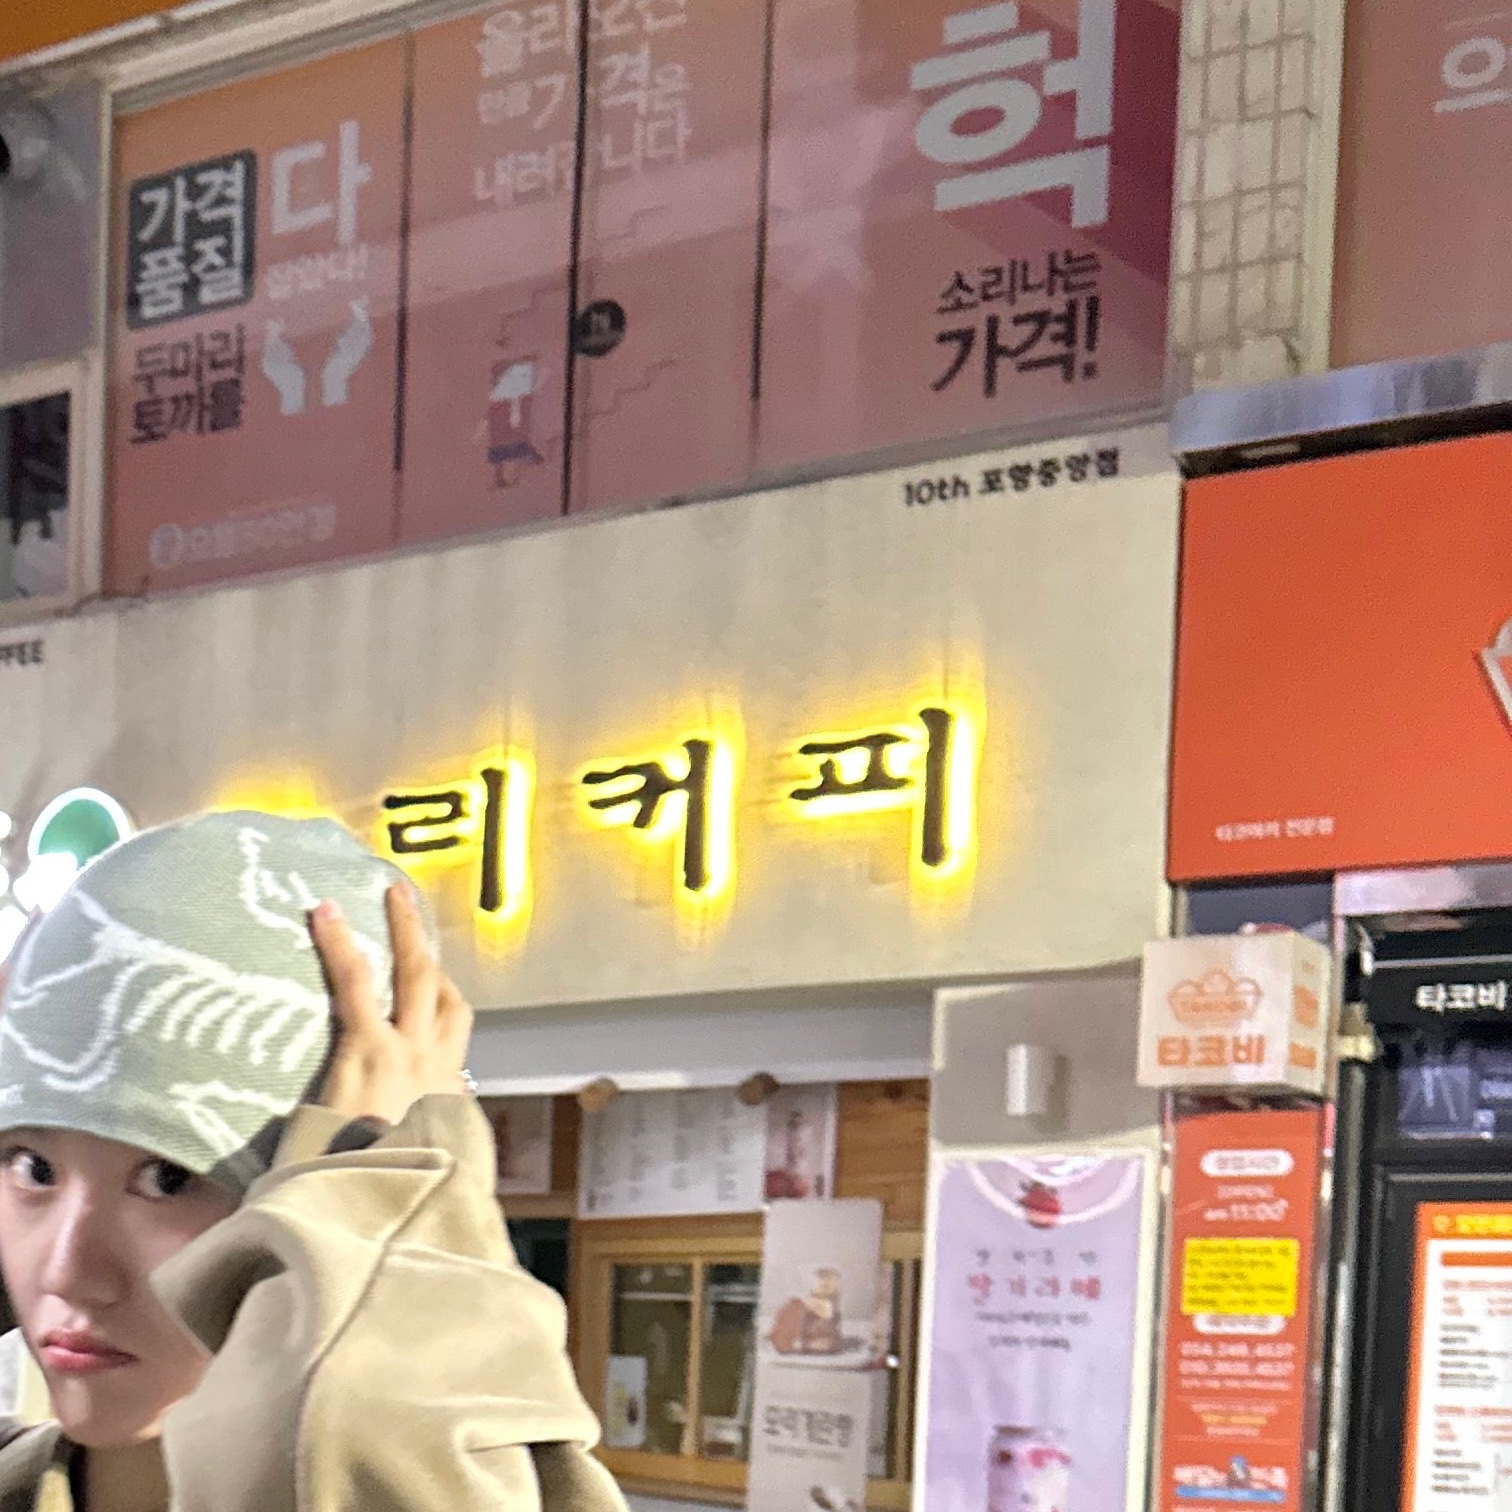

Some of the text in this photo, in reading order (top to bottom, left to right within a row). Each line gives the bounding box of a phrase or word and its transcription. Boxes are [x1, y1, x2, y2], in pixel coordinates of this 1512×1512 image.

[910, 0, 1116, 229] 헉
[138, 158, 247, 244] 가격
[270, 118, 374, 246] 다
[135, 232, 247, 320] 품질
[935, 250, 1102, 315] 소리나는
[133, 322, 245, 396] 두마리
[930, 297, 1101, 398] 가격!
[903, 471, 971, 508] 10th
[381, 706, 954, 914] 리커피
[1415, 979, 1506, 1014] 타코비
[1157, 1033, 1267, 1069] 타코비
